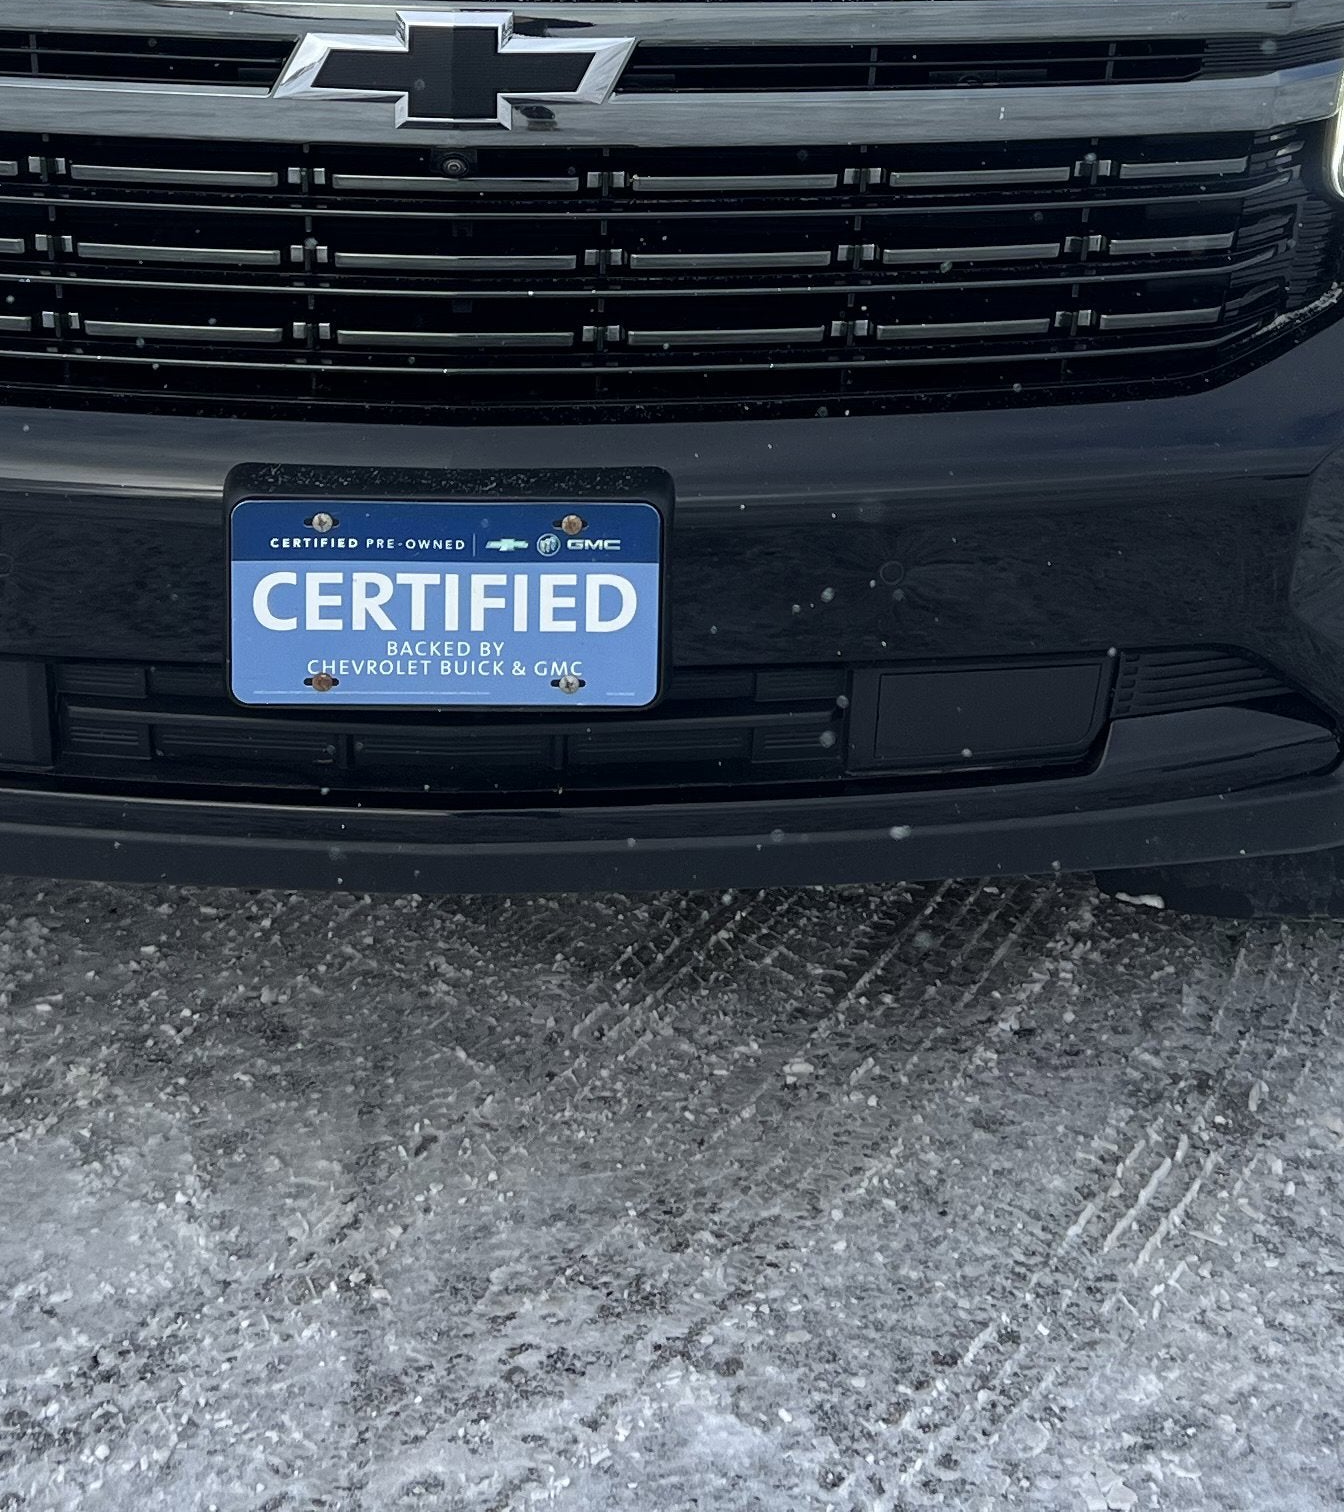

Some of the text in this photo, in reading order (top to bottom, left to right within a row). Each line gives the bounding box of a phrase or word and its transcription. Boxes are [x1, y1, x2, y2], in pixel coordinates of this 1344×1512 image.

[269, 537, 466, 551] CERTIFIED PRE-OWNED
[566, 538, 622, 551] GMC
[252, 570, 638, 633] CERTIFIED
[386, 640, 506, 657] BACKED BY
[306, 658, 584, 677] CHEVROLET BUICK & GMC
